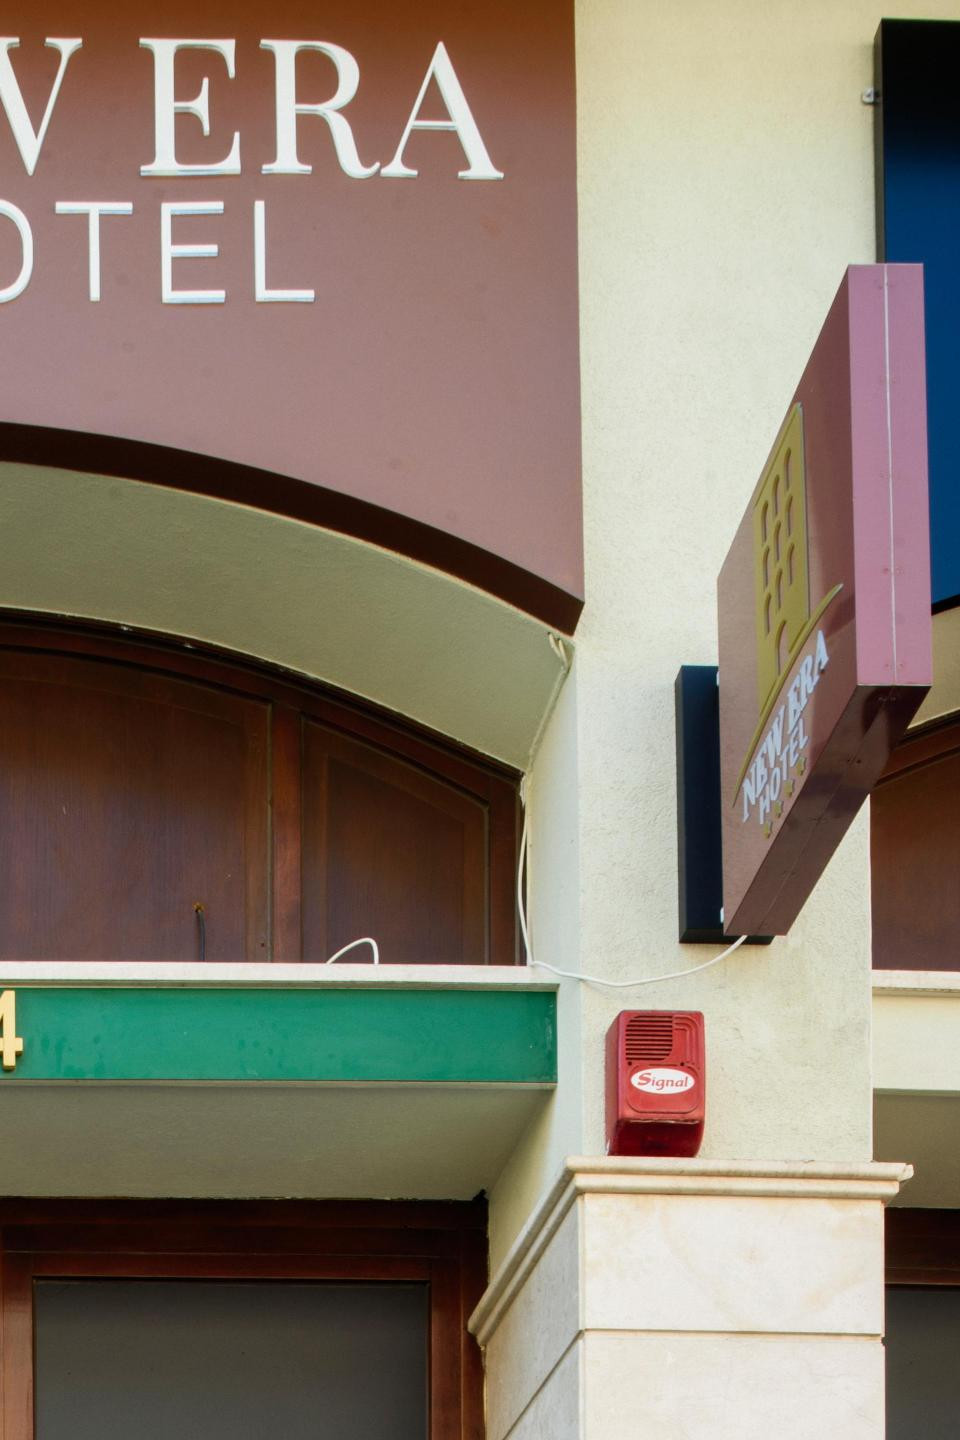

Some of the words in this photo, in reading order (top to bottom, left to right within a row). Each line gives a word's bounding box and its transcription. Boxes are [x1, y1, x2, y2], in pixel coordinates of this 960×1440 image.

[138, 37, 505, 180] ERA
[743, 705, 785, 822] NEW
[788, 630, 829, 735] ERA
[759, 718, 808, 824] HOTEL
[637, 1072, 688, 1091] Signal
